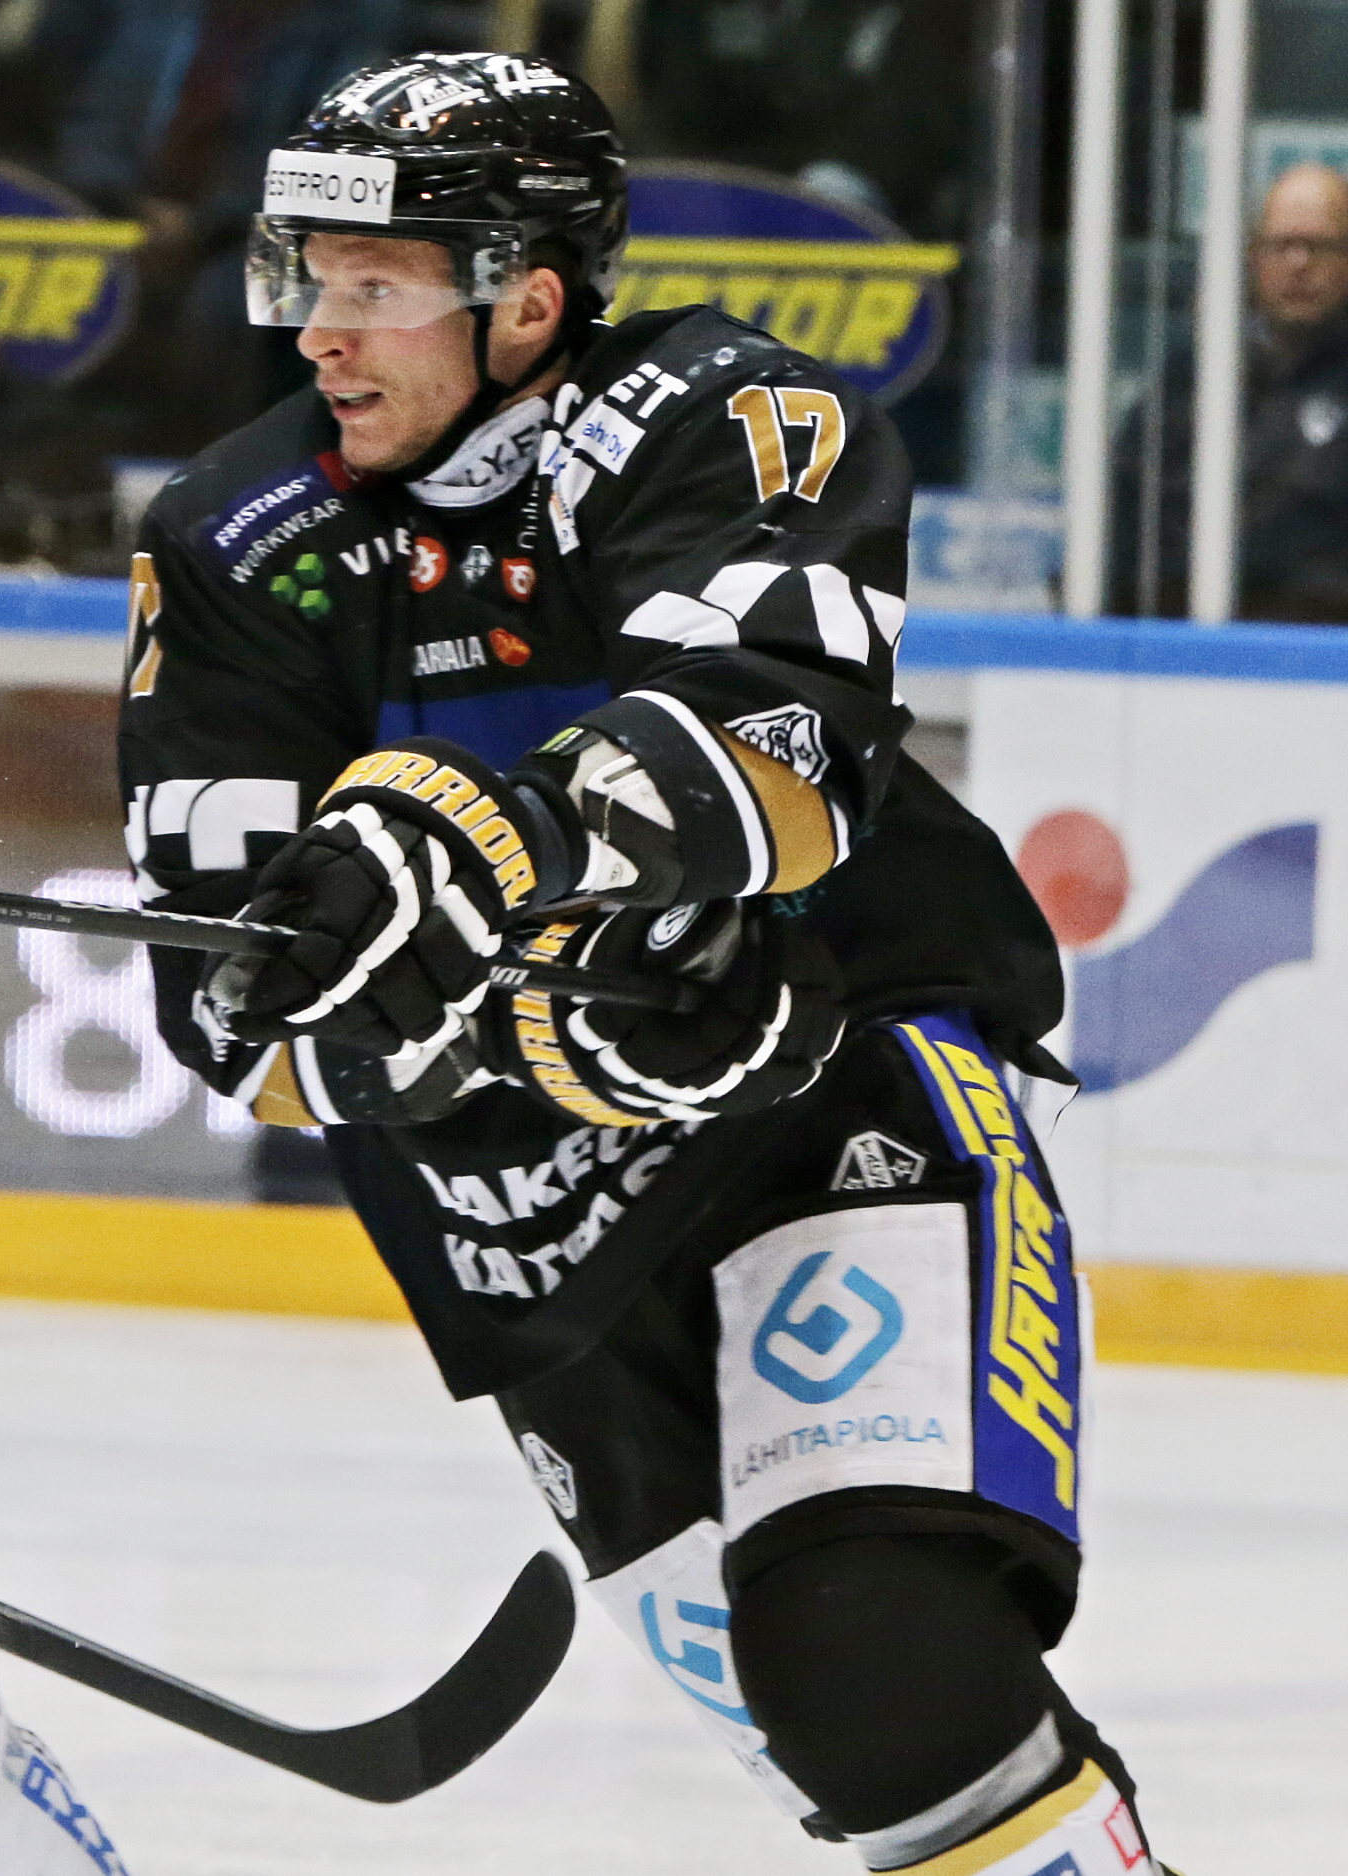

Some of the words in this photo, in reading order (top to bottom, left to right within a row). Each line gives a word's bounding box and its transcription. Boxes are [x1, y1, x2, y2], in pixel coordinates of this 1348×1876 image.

[350, 177, 390, 205] OY
[727, 384, 847, 504] 17
[230, 498, 347, 584] WORKWEAR
[316, 750, 538, 911] ARRIOR
